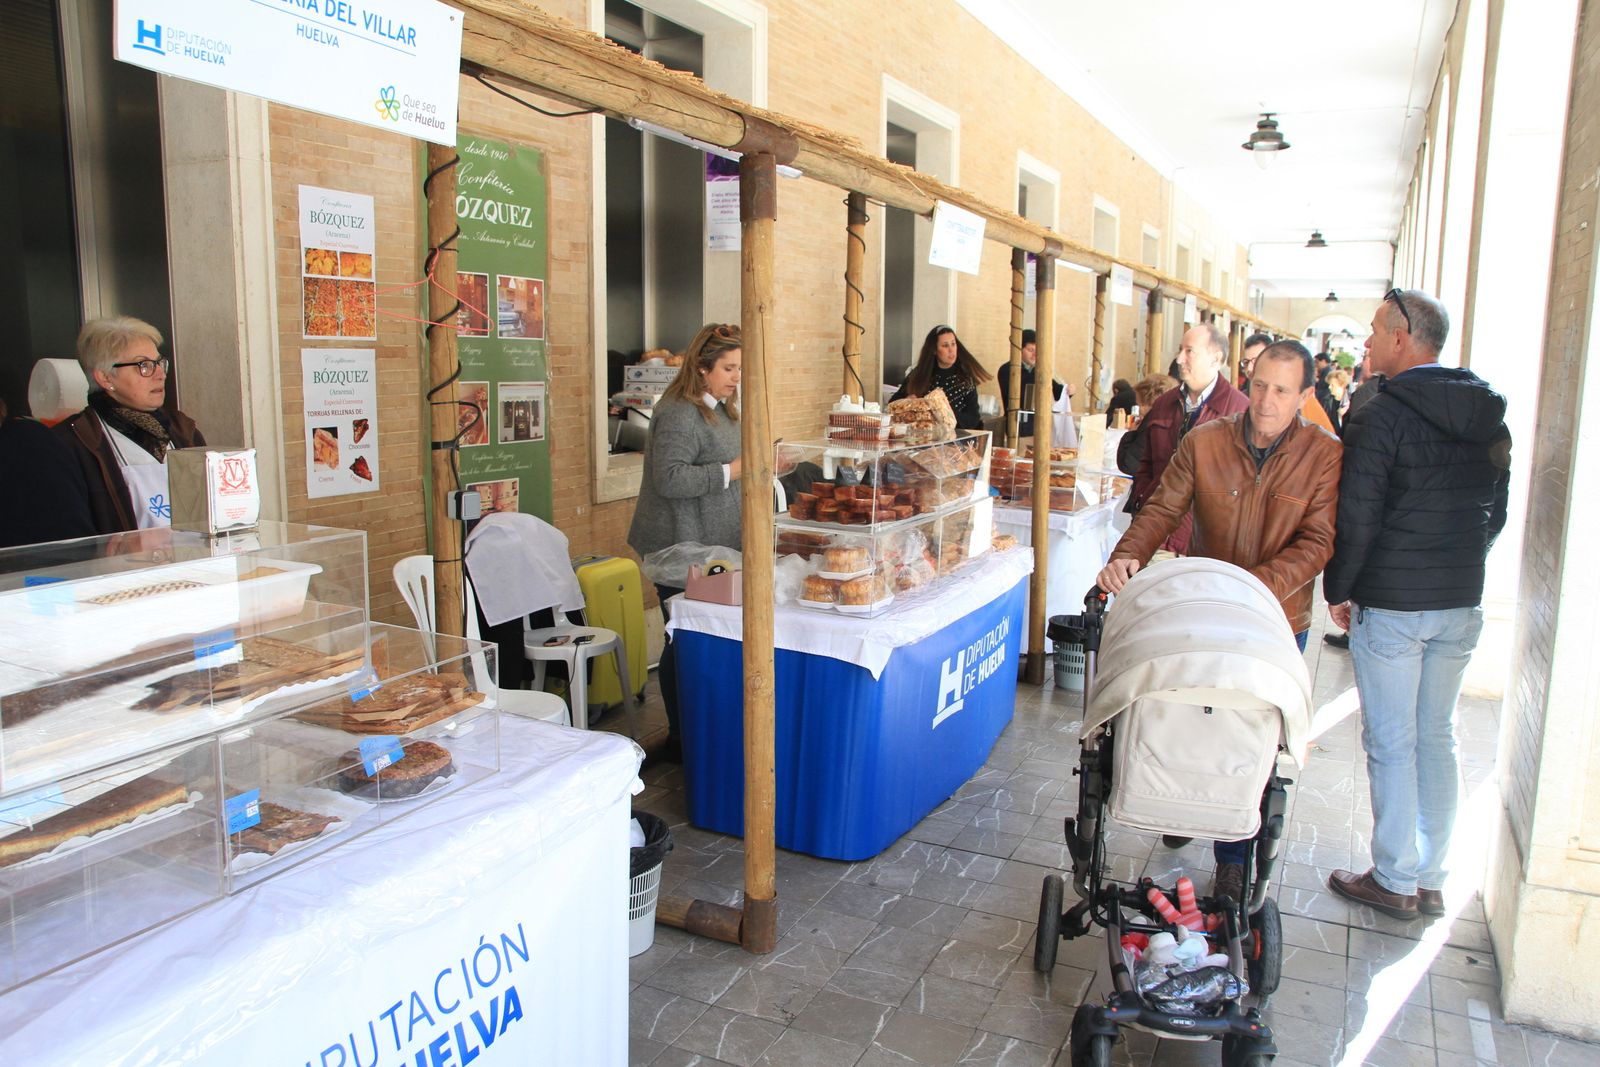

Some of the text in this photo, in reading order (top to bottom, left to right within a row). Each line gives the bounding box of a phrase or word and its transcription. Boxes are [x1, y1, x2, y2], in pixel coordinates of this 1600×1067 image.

[137, 19, 162, 48] H
[296, 23, 340, 48] HUELVA
[324, 0, 357, 26] DEL
[363, 10, 417, 47] VILLAR
[166, 27, 232, 55] DIPUTACIÓN
[166, 41, 226, 66] DE HUELVA
[403, 94, 437, 114] Que sea
[402, 109, 446, 130] de Huelva
[464, 141, 509, 161] desde 1940
[310, 209, 365, 230] BÓZQUEZ
[456, 191, 533, 229] ÓZQUEZ
[313, 368, 369, 386] BÓZQUEZ
[331, 409, 355, 417] RELLENAS
[965, 615, 1010, 668] DIPUTACIÓN
[937, 649, 966, 714] H
[963, 642, 1006, 696] DE HUELVA
[305, 922, 530, 1067] PUTACIÓN
[400, 985, 524, 1067] ELVA
